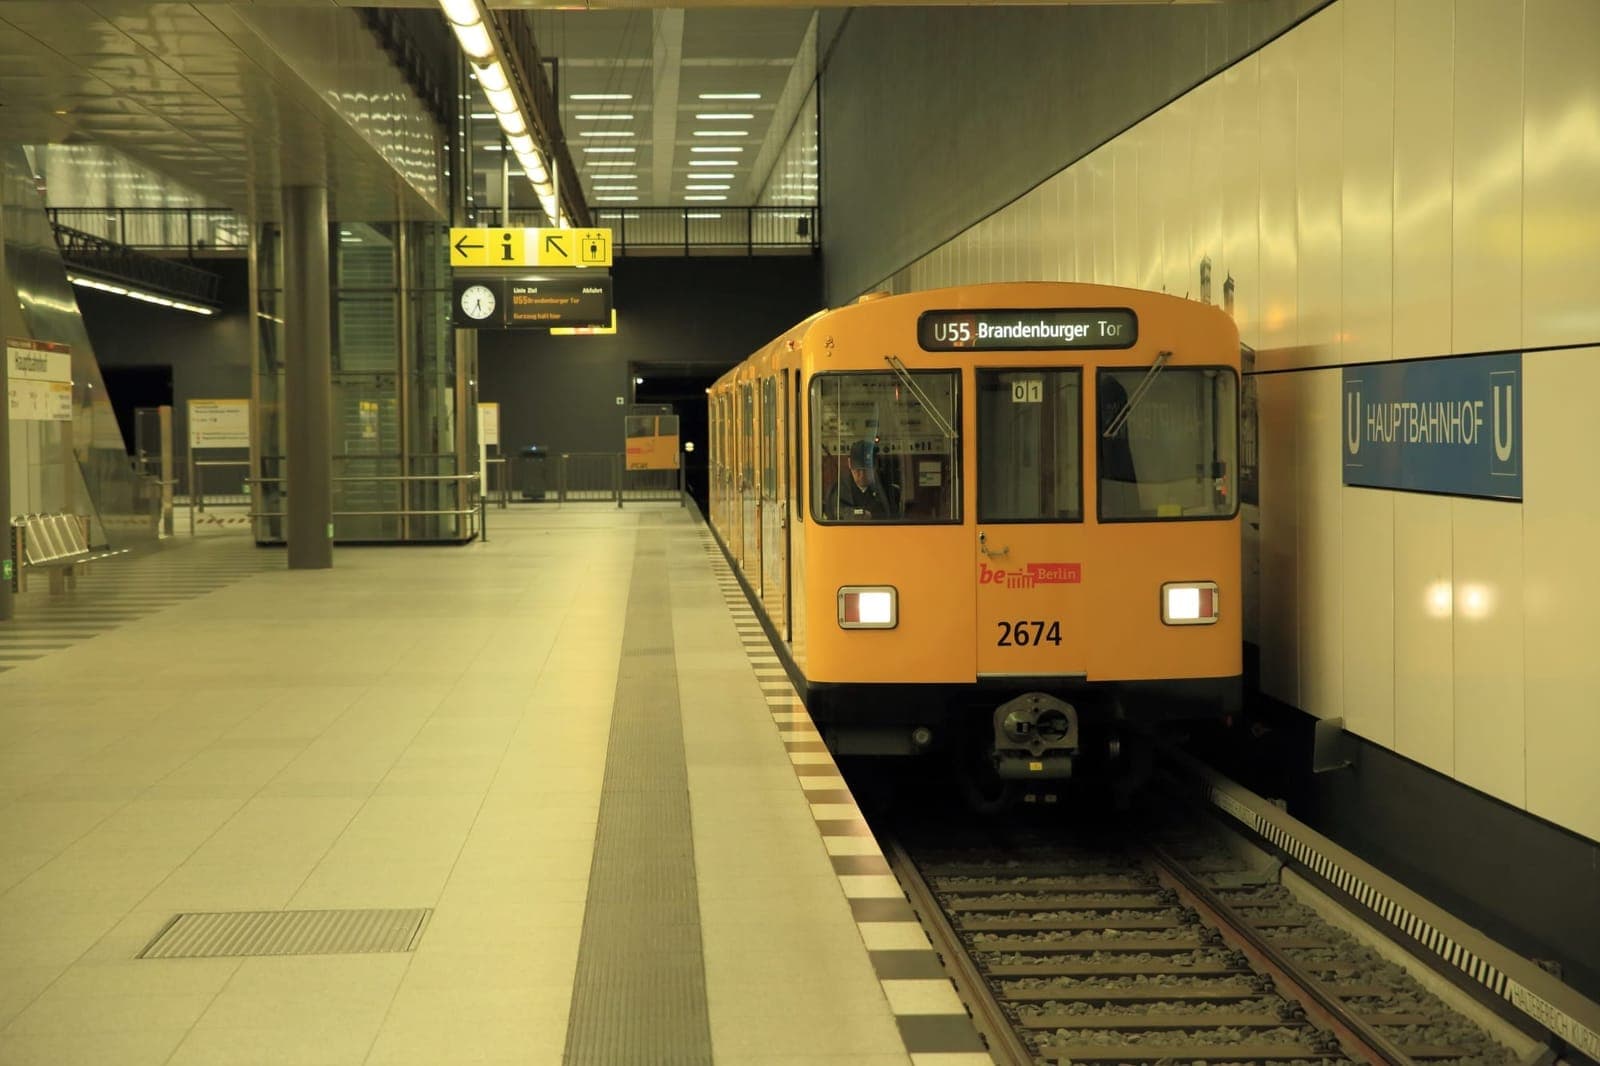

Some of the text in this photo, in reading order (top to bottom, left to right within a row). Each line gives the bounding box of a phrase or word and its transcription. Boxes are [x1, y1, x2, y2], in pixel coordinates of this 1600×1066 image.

[934, 320, 1124, 342] U55 Brandenburger Tor
[1348, 384, 1513, 462] U HAUPTBAHNHOF U
[979, 563, 1077, 585] be Berlin
[996, 620, 1063, 647] 2674
